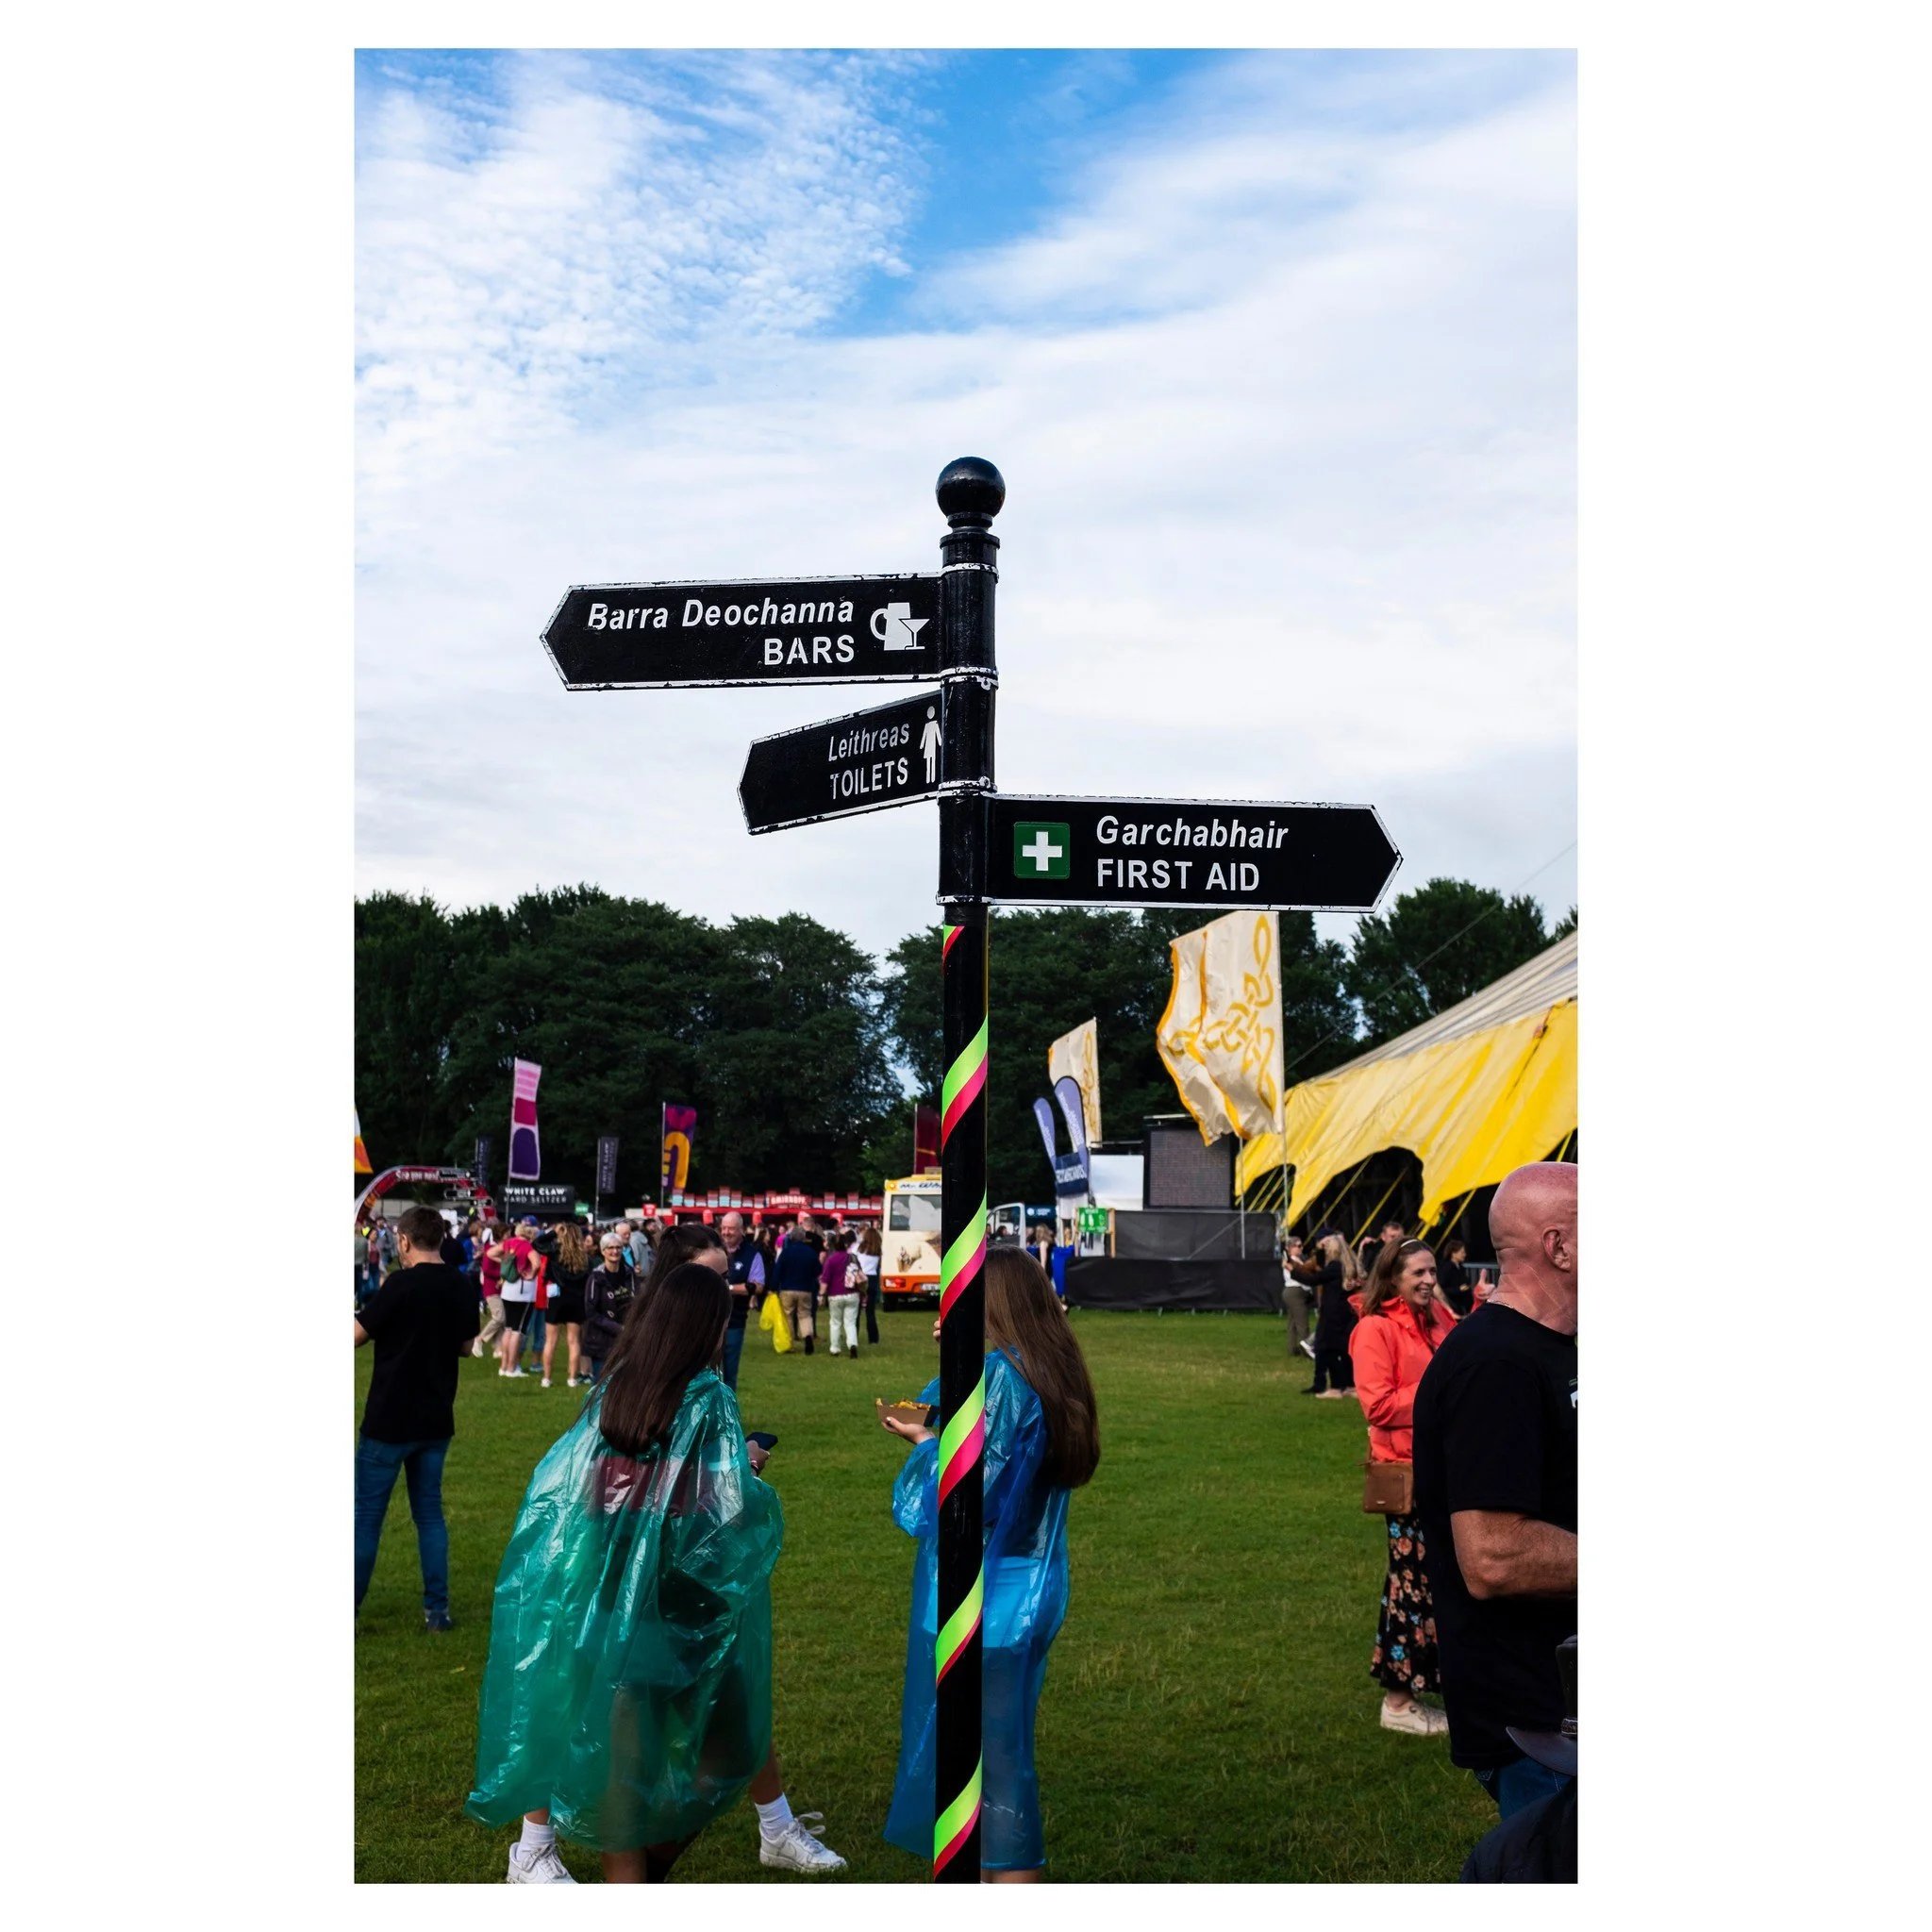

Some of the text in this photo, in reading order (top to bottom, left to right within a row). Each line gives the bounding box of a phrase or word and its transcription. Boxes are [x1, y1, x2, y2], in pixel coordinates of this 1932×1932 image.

[587, 597, 854, 630] Barra Deochanna
[764, 634, 855, 666] BARS
[828, 722, 910, 762] Leithreas
[829, 758, 908, 800] TOILETS
[1096, 815, 1290, 849] Garchabhair
[1097, 858, 1259, 891] FIRST AID
[505, 1187, 566, 1196] WHITE CLAW
